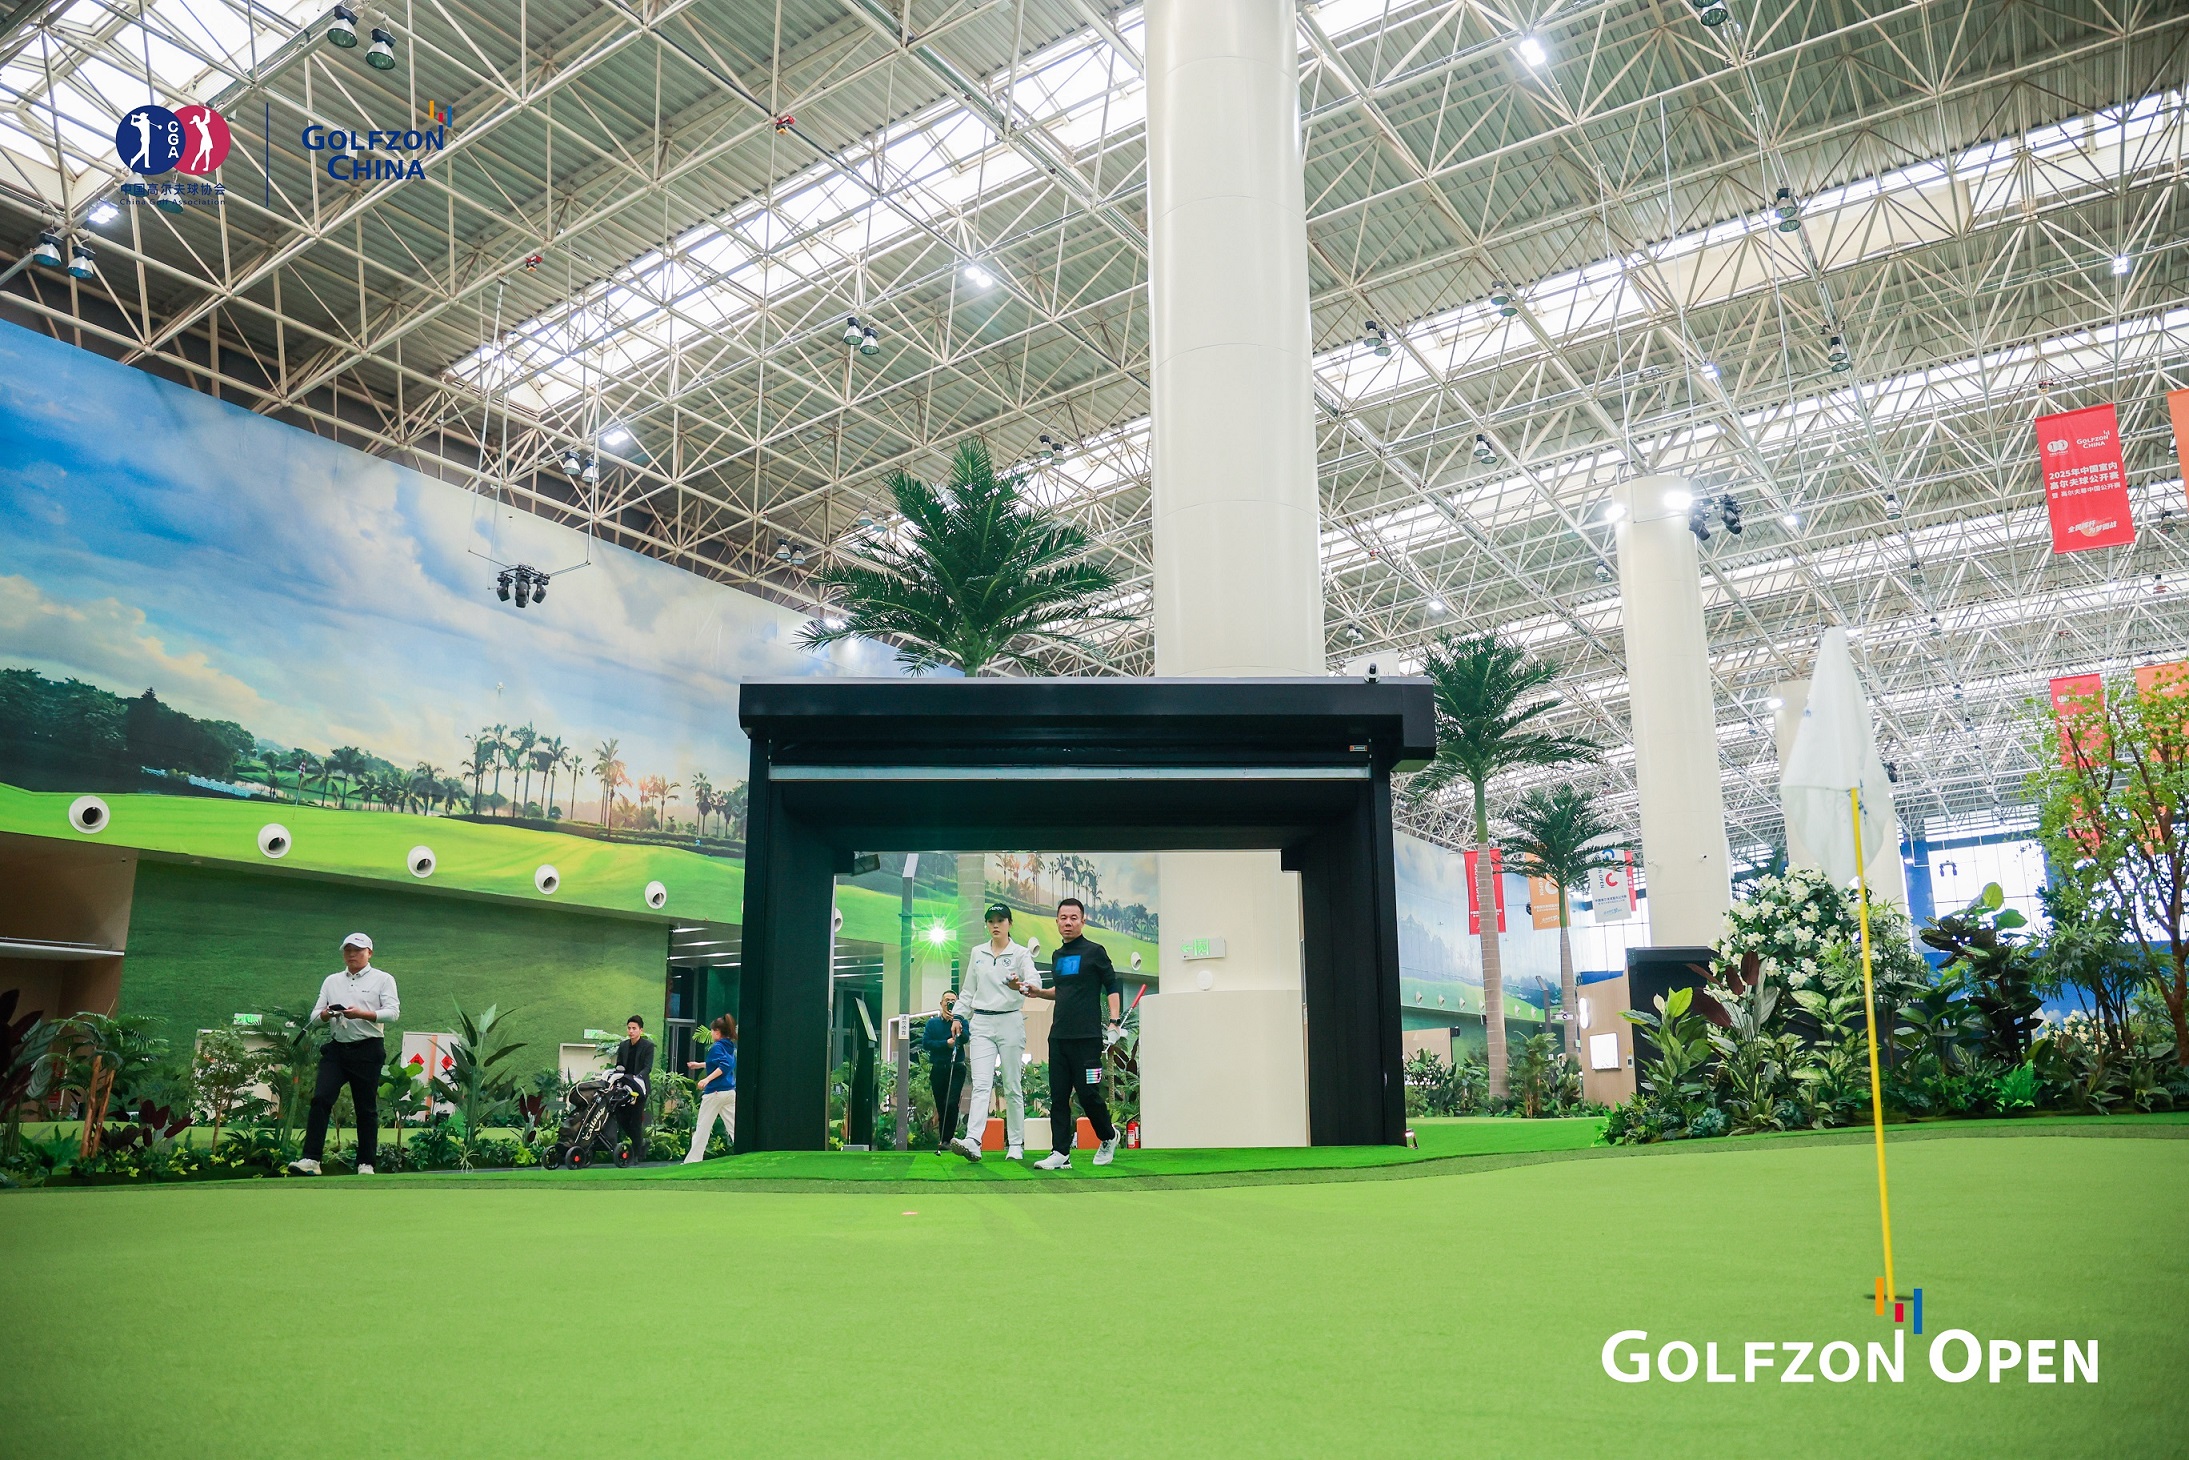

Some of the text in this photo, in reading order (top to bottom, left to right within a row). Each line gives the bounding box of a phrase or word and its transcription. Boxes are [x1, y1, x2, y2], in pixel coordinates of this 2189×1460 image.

[2082, 441, 2106, 449] CHINA
[2049, 462, 2118, 480] 2025年中国室内
[2050, 471, 2119, 490] 高尔夫球公开赛
